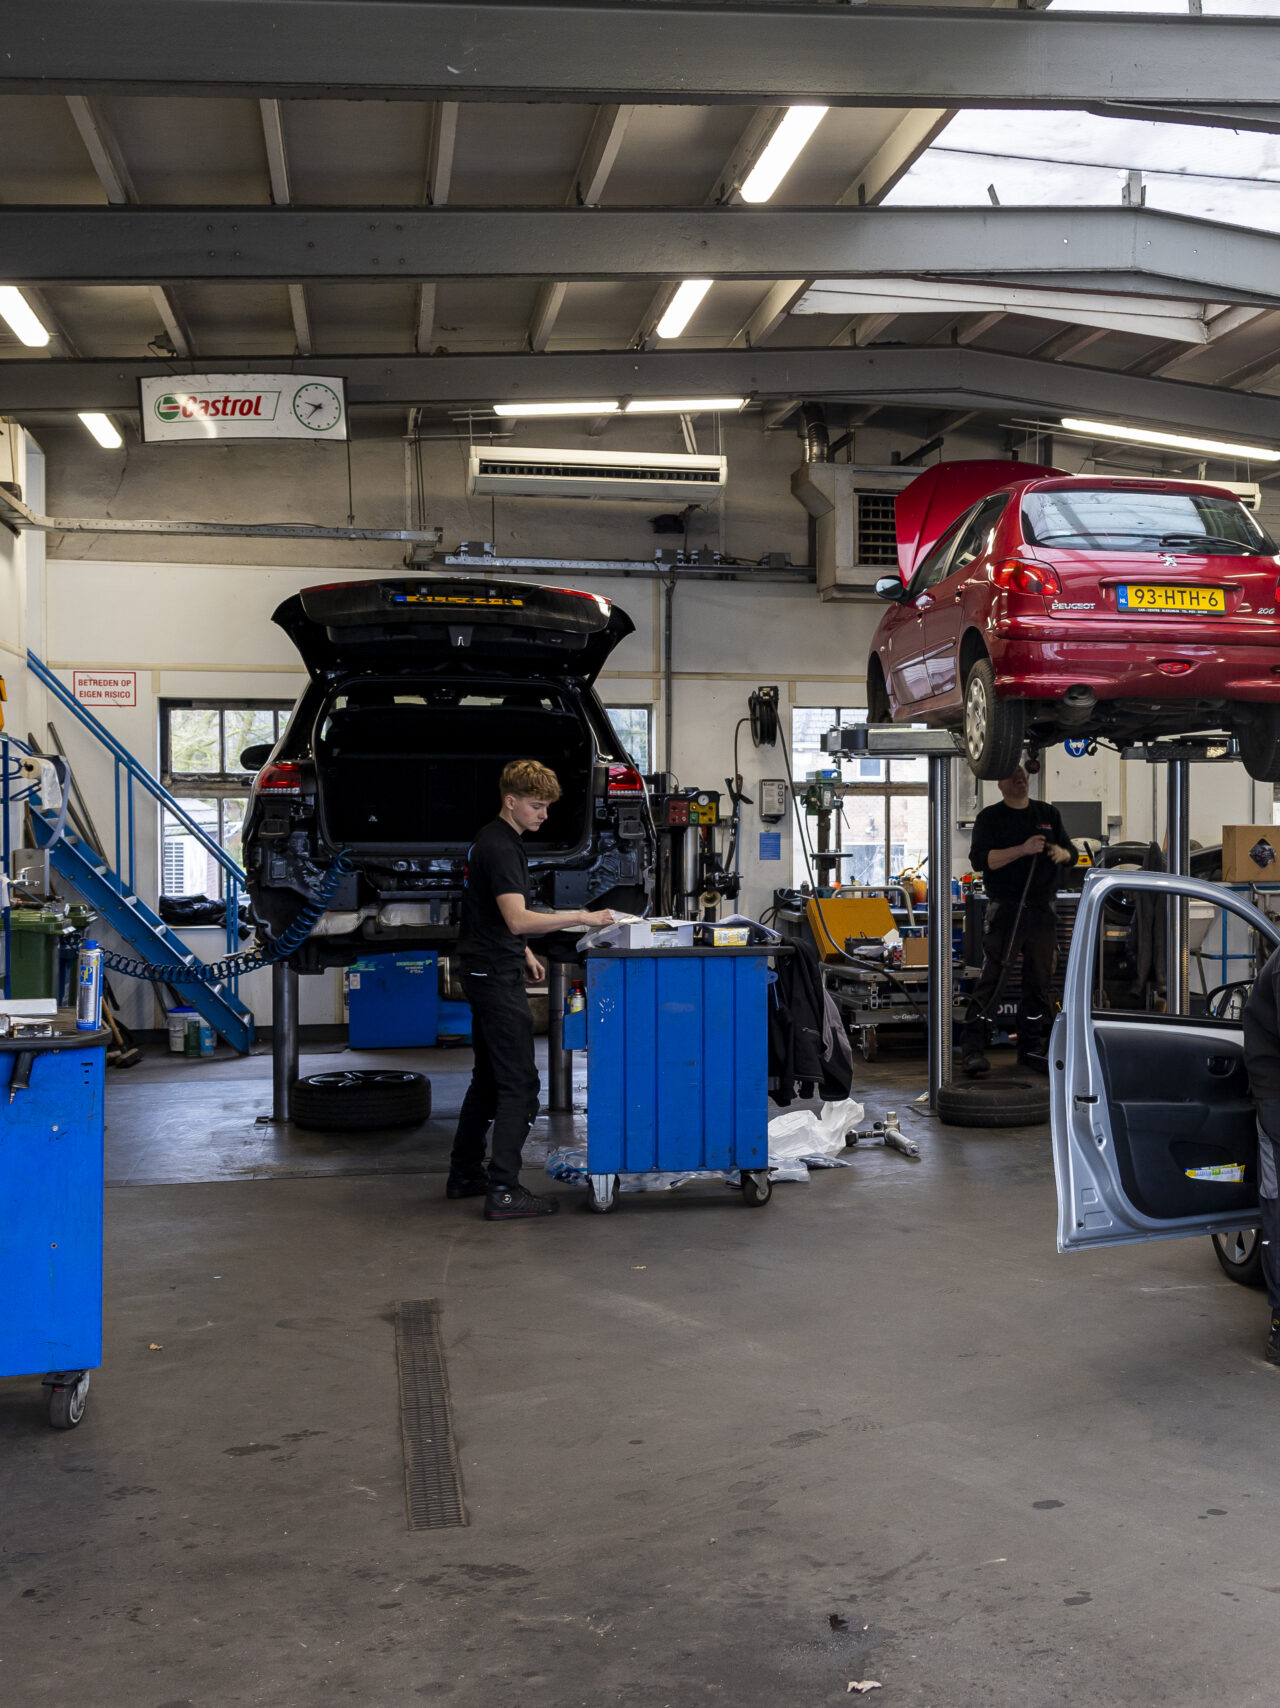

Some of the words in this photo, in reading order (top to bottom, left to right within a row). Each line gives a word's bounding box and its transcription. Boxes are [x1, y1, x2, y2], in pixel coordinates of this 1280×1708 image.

[181, 395, 262, 418] Castrol
[1134, 588, 1218, 607] 93-HTH-6
[1051, 602, 1096, 610] PEUGEOT
[1257, 607, 1275, 615] 206
[78, 679, 119, 687] BETREDEN
[120, 679, 132, 687] OP
[79, 690, 102, 698] EIGEN
[104, 690, 131, 699] RISICO
